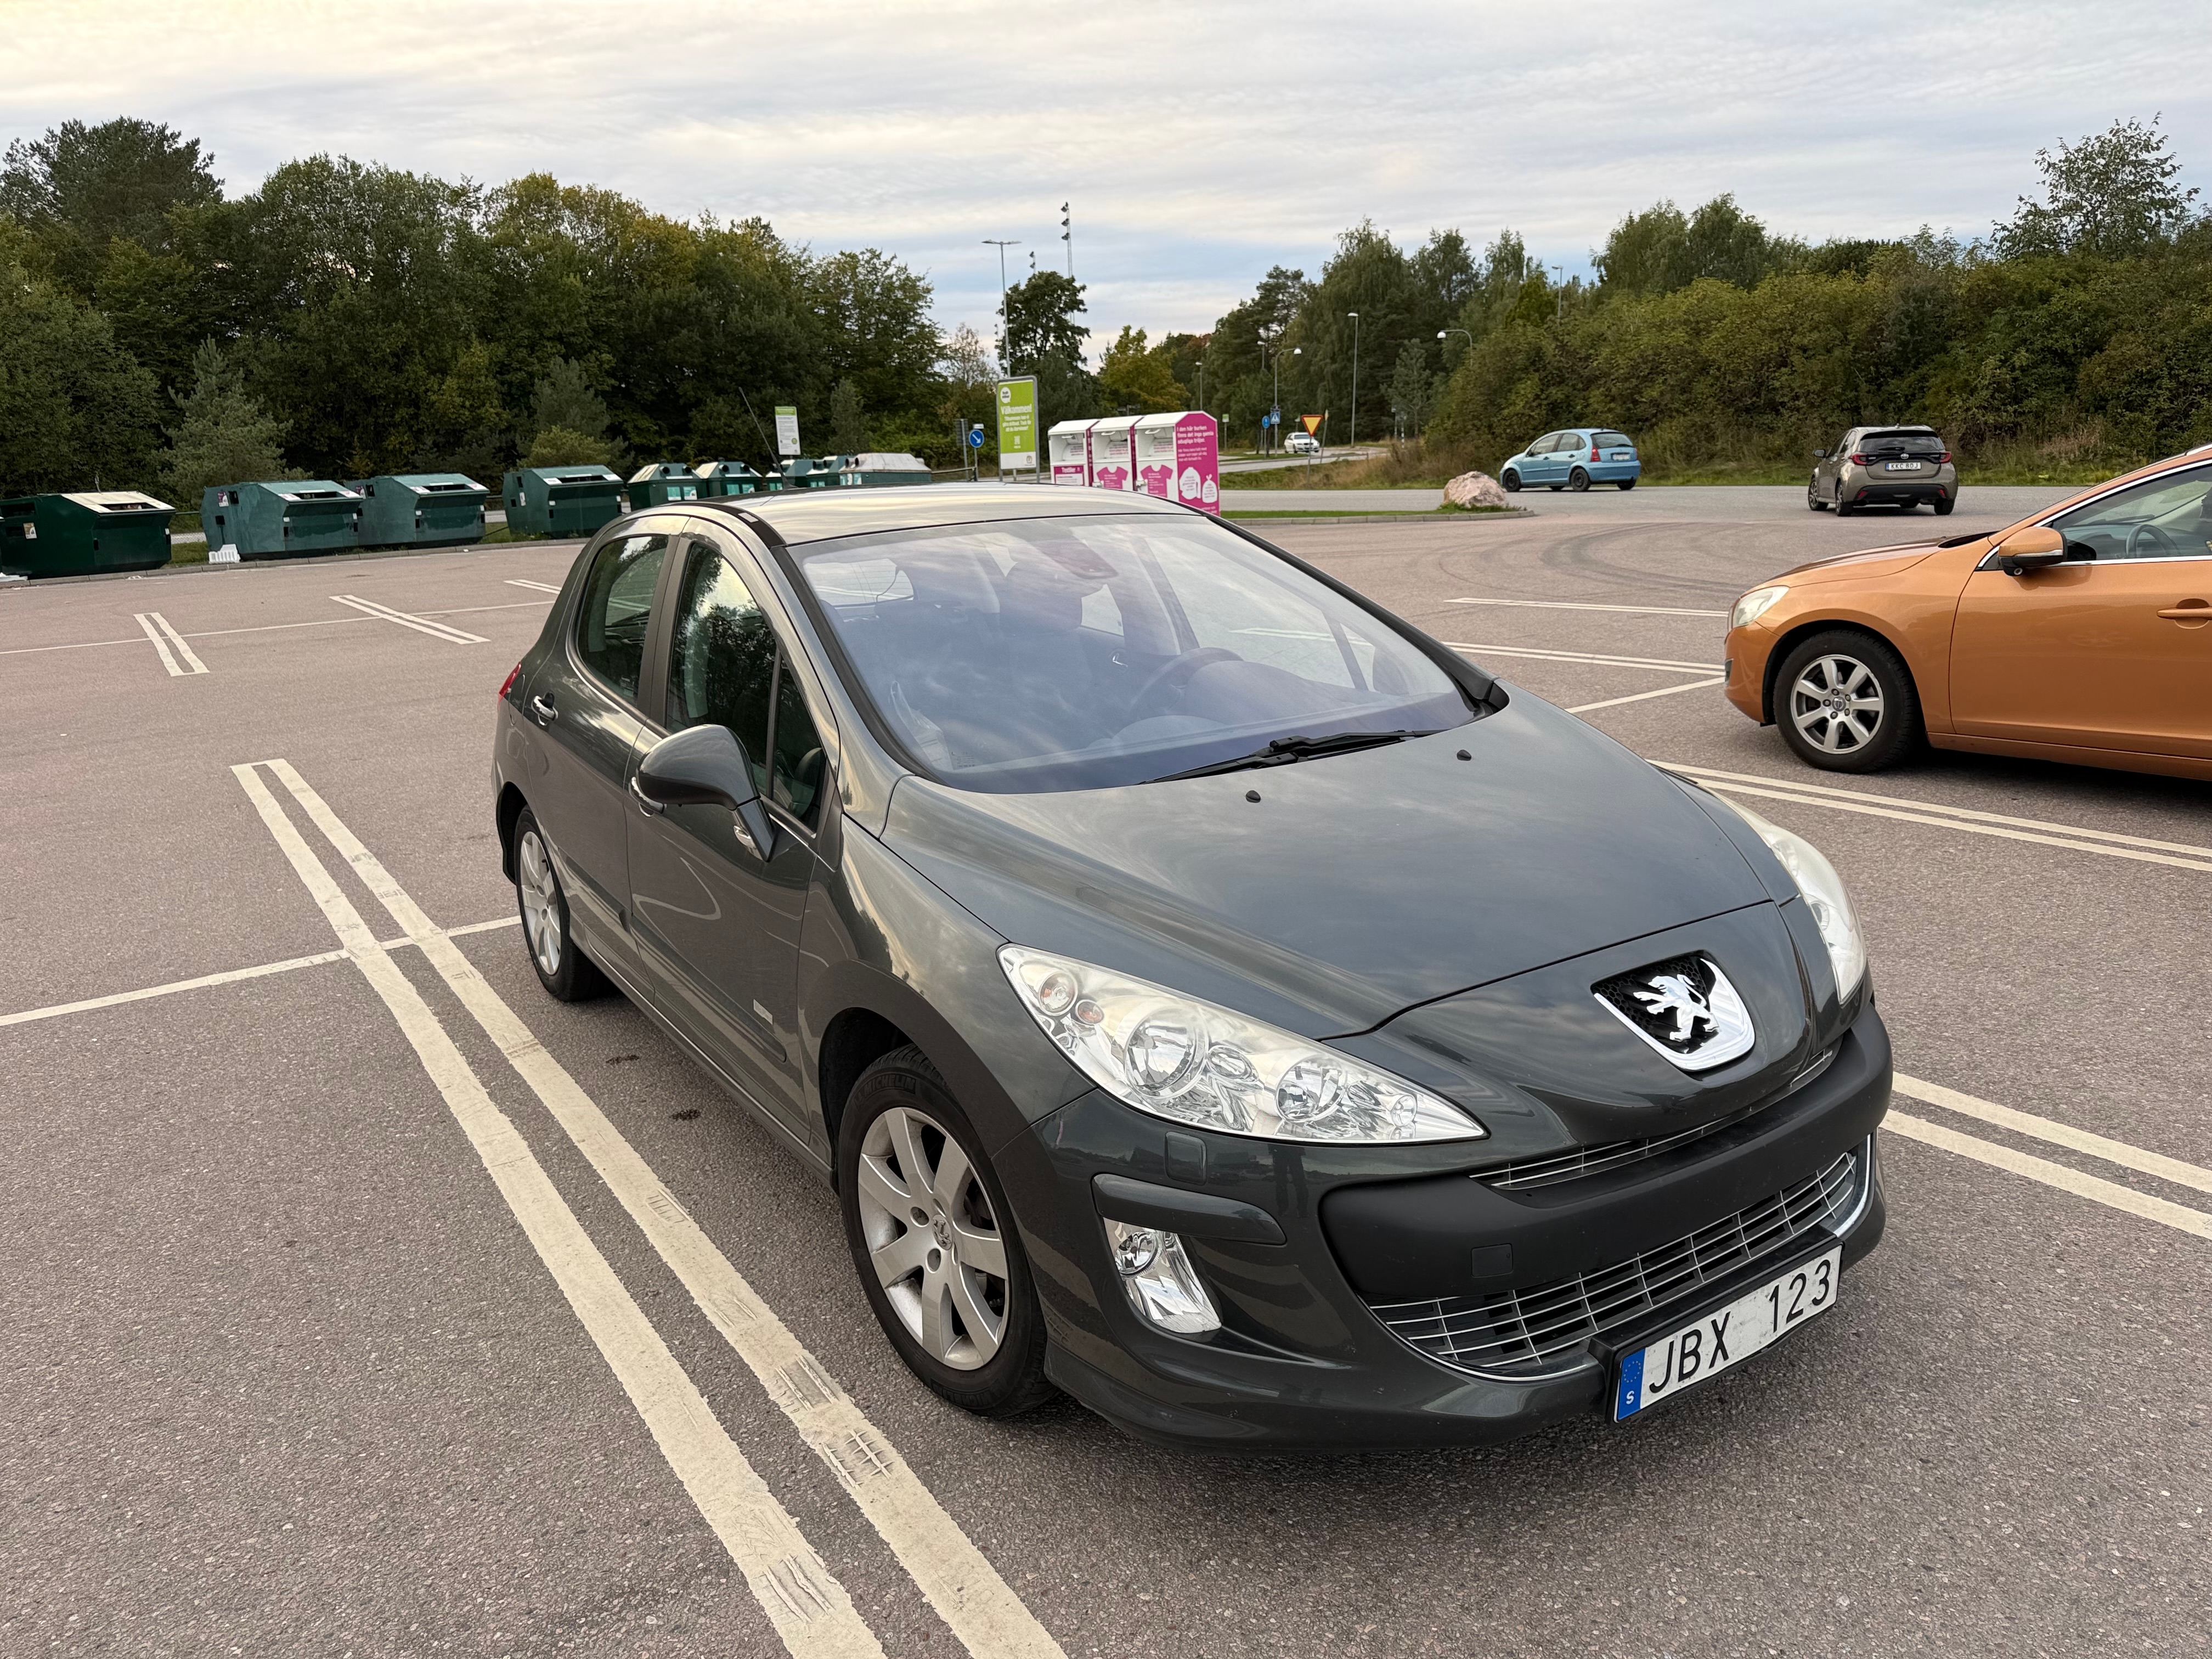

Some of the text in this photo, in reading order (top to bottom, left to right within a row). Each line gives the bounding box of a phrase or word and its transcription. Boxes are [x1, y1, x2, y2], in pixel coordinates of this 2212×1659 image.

[864, 1074, 916, 1095] MICHELIN
[1649, 1259, 1832, 1394] JBX 123
[1626, 1390, 1635, 1404] S
